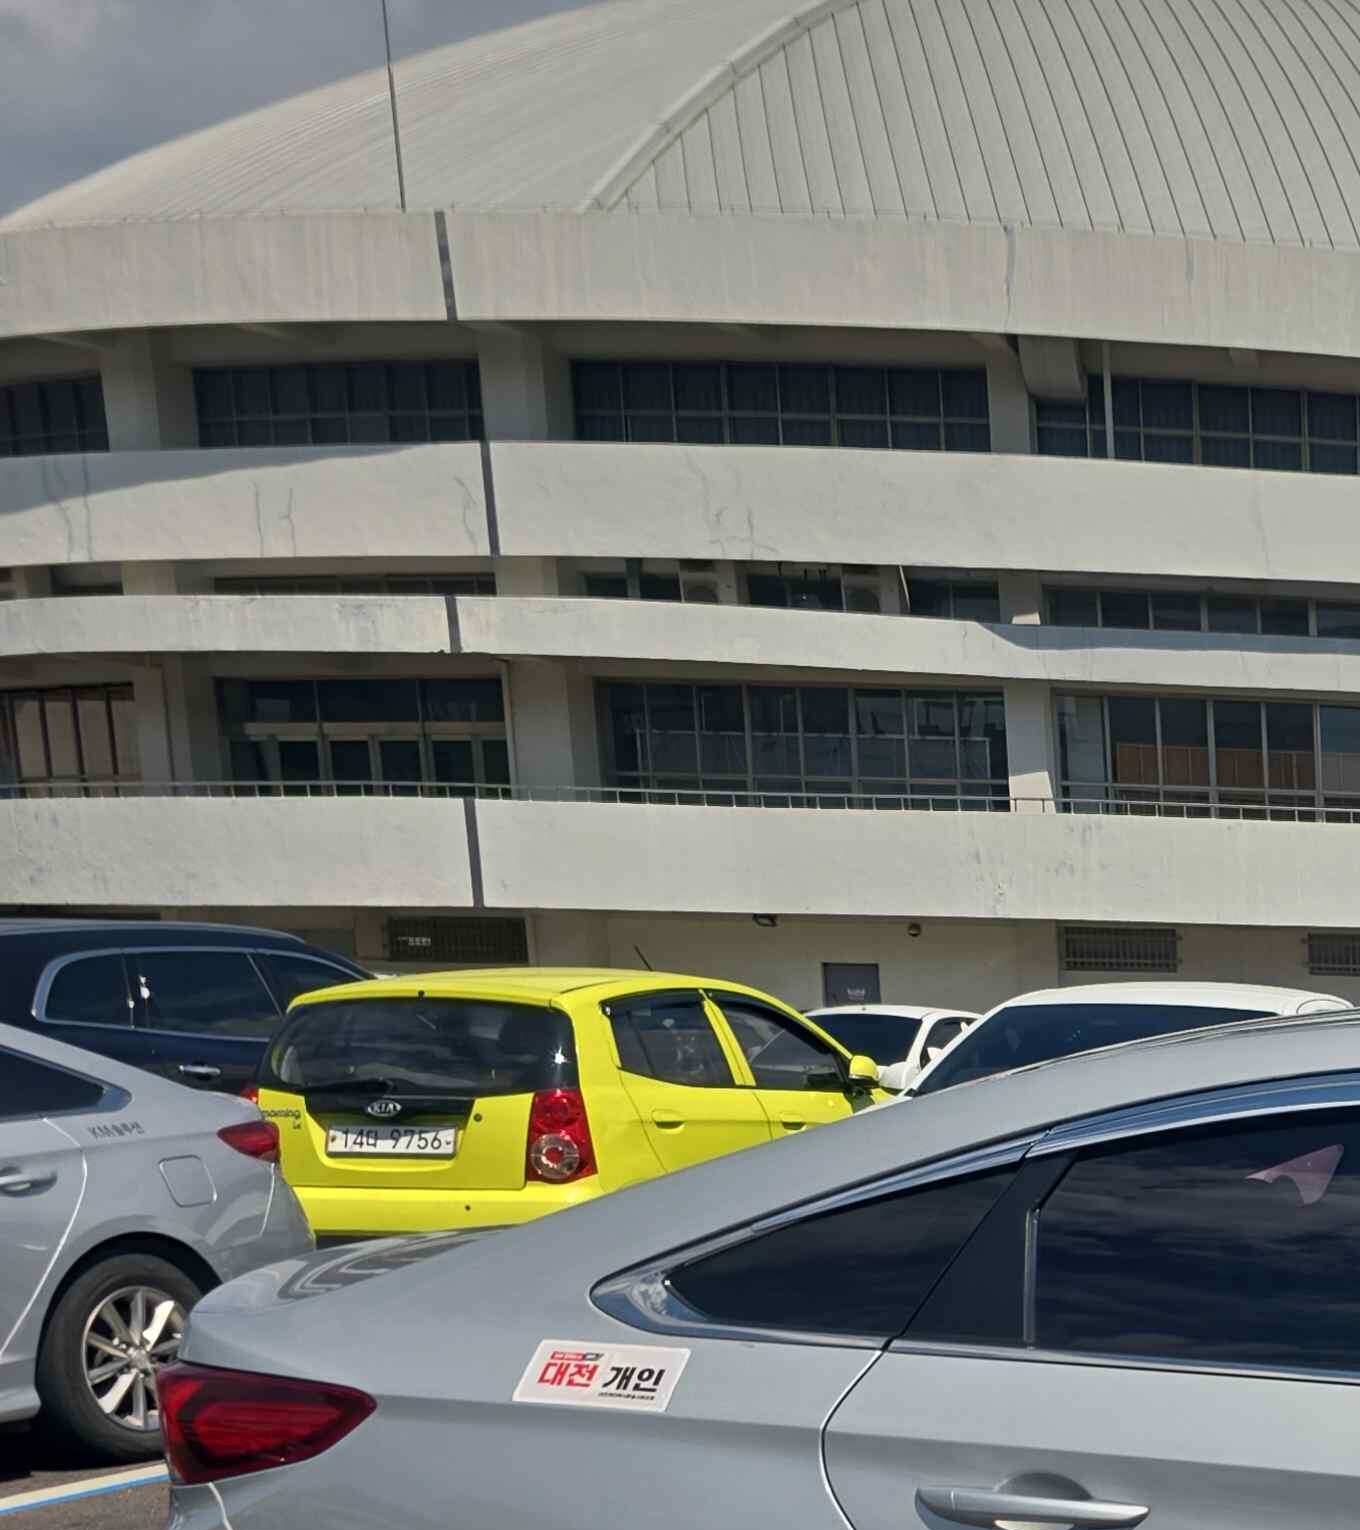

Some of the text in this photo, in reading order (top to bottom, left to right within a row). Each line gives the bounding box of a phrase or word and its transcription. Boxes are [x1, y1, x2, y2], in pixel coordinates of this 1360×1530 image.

[390, 1128, 442, 1150] 9756
[538, 1362, 666, 1393] 대전 개인
